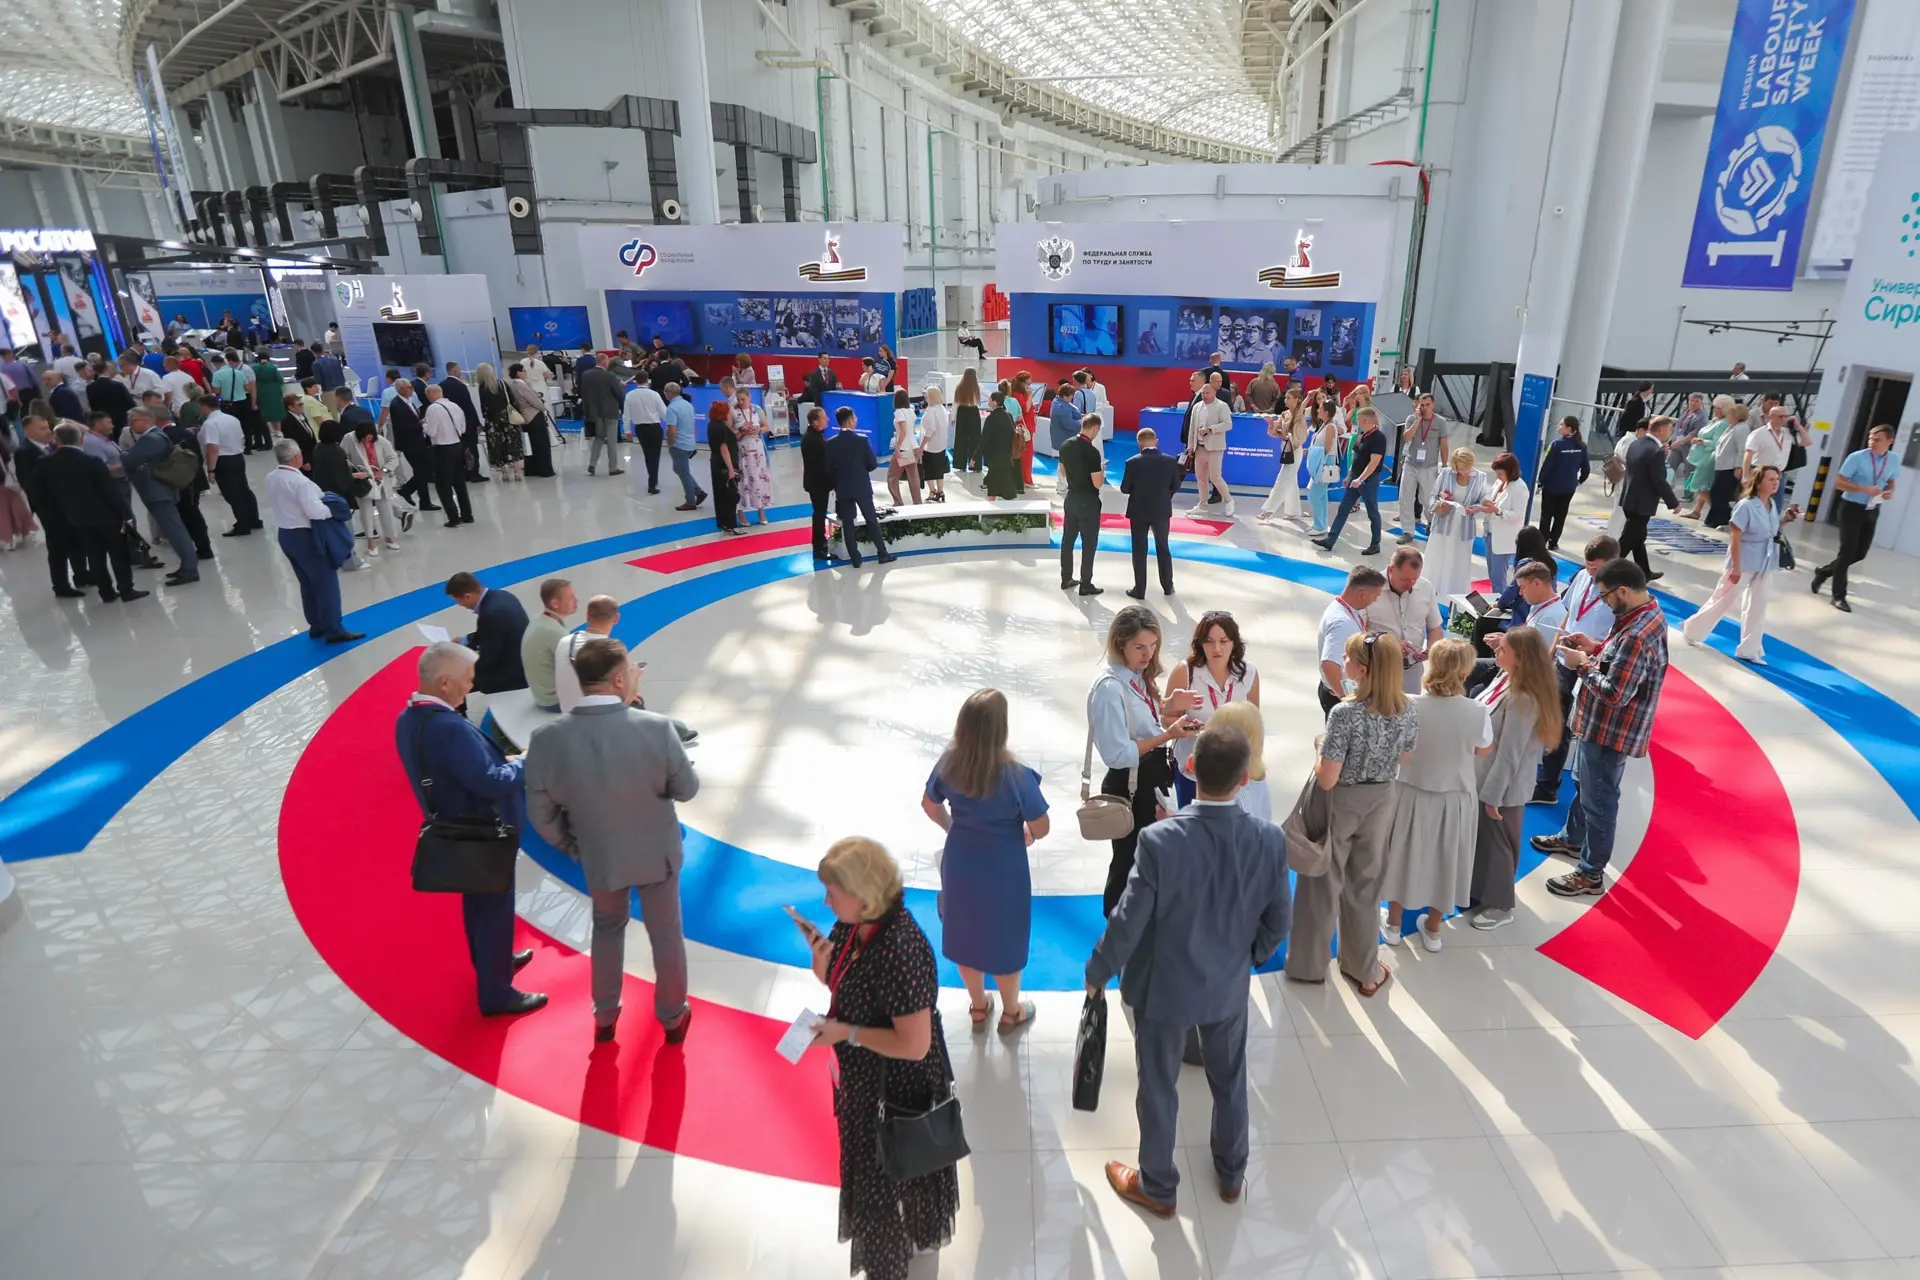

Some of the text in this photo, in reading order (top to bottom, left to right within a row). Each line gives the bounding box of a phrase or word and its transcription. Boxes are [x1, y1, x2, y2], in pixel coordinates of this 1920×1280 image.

[1739, 53, 1758, 110] RUSSIAN
[1771, 1, 1808, 105] SAFETY
[1791, 16, 1827, 104] WEEK
